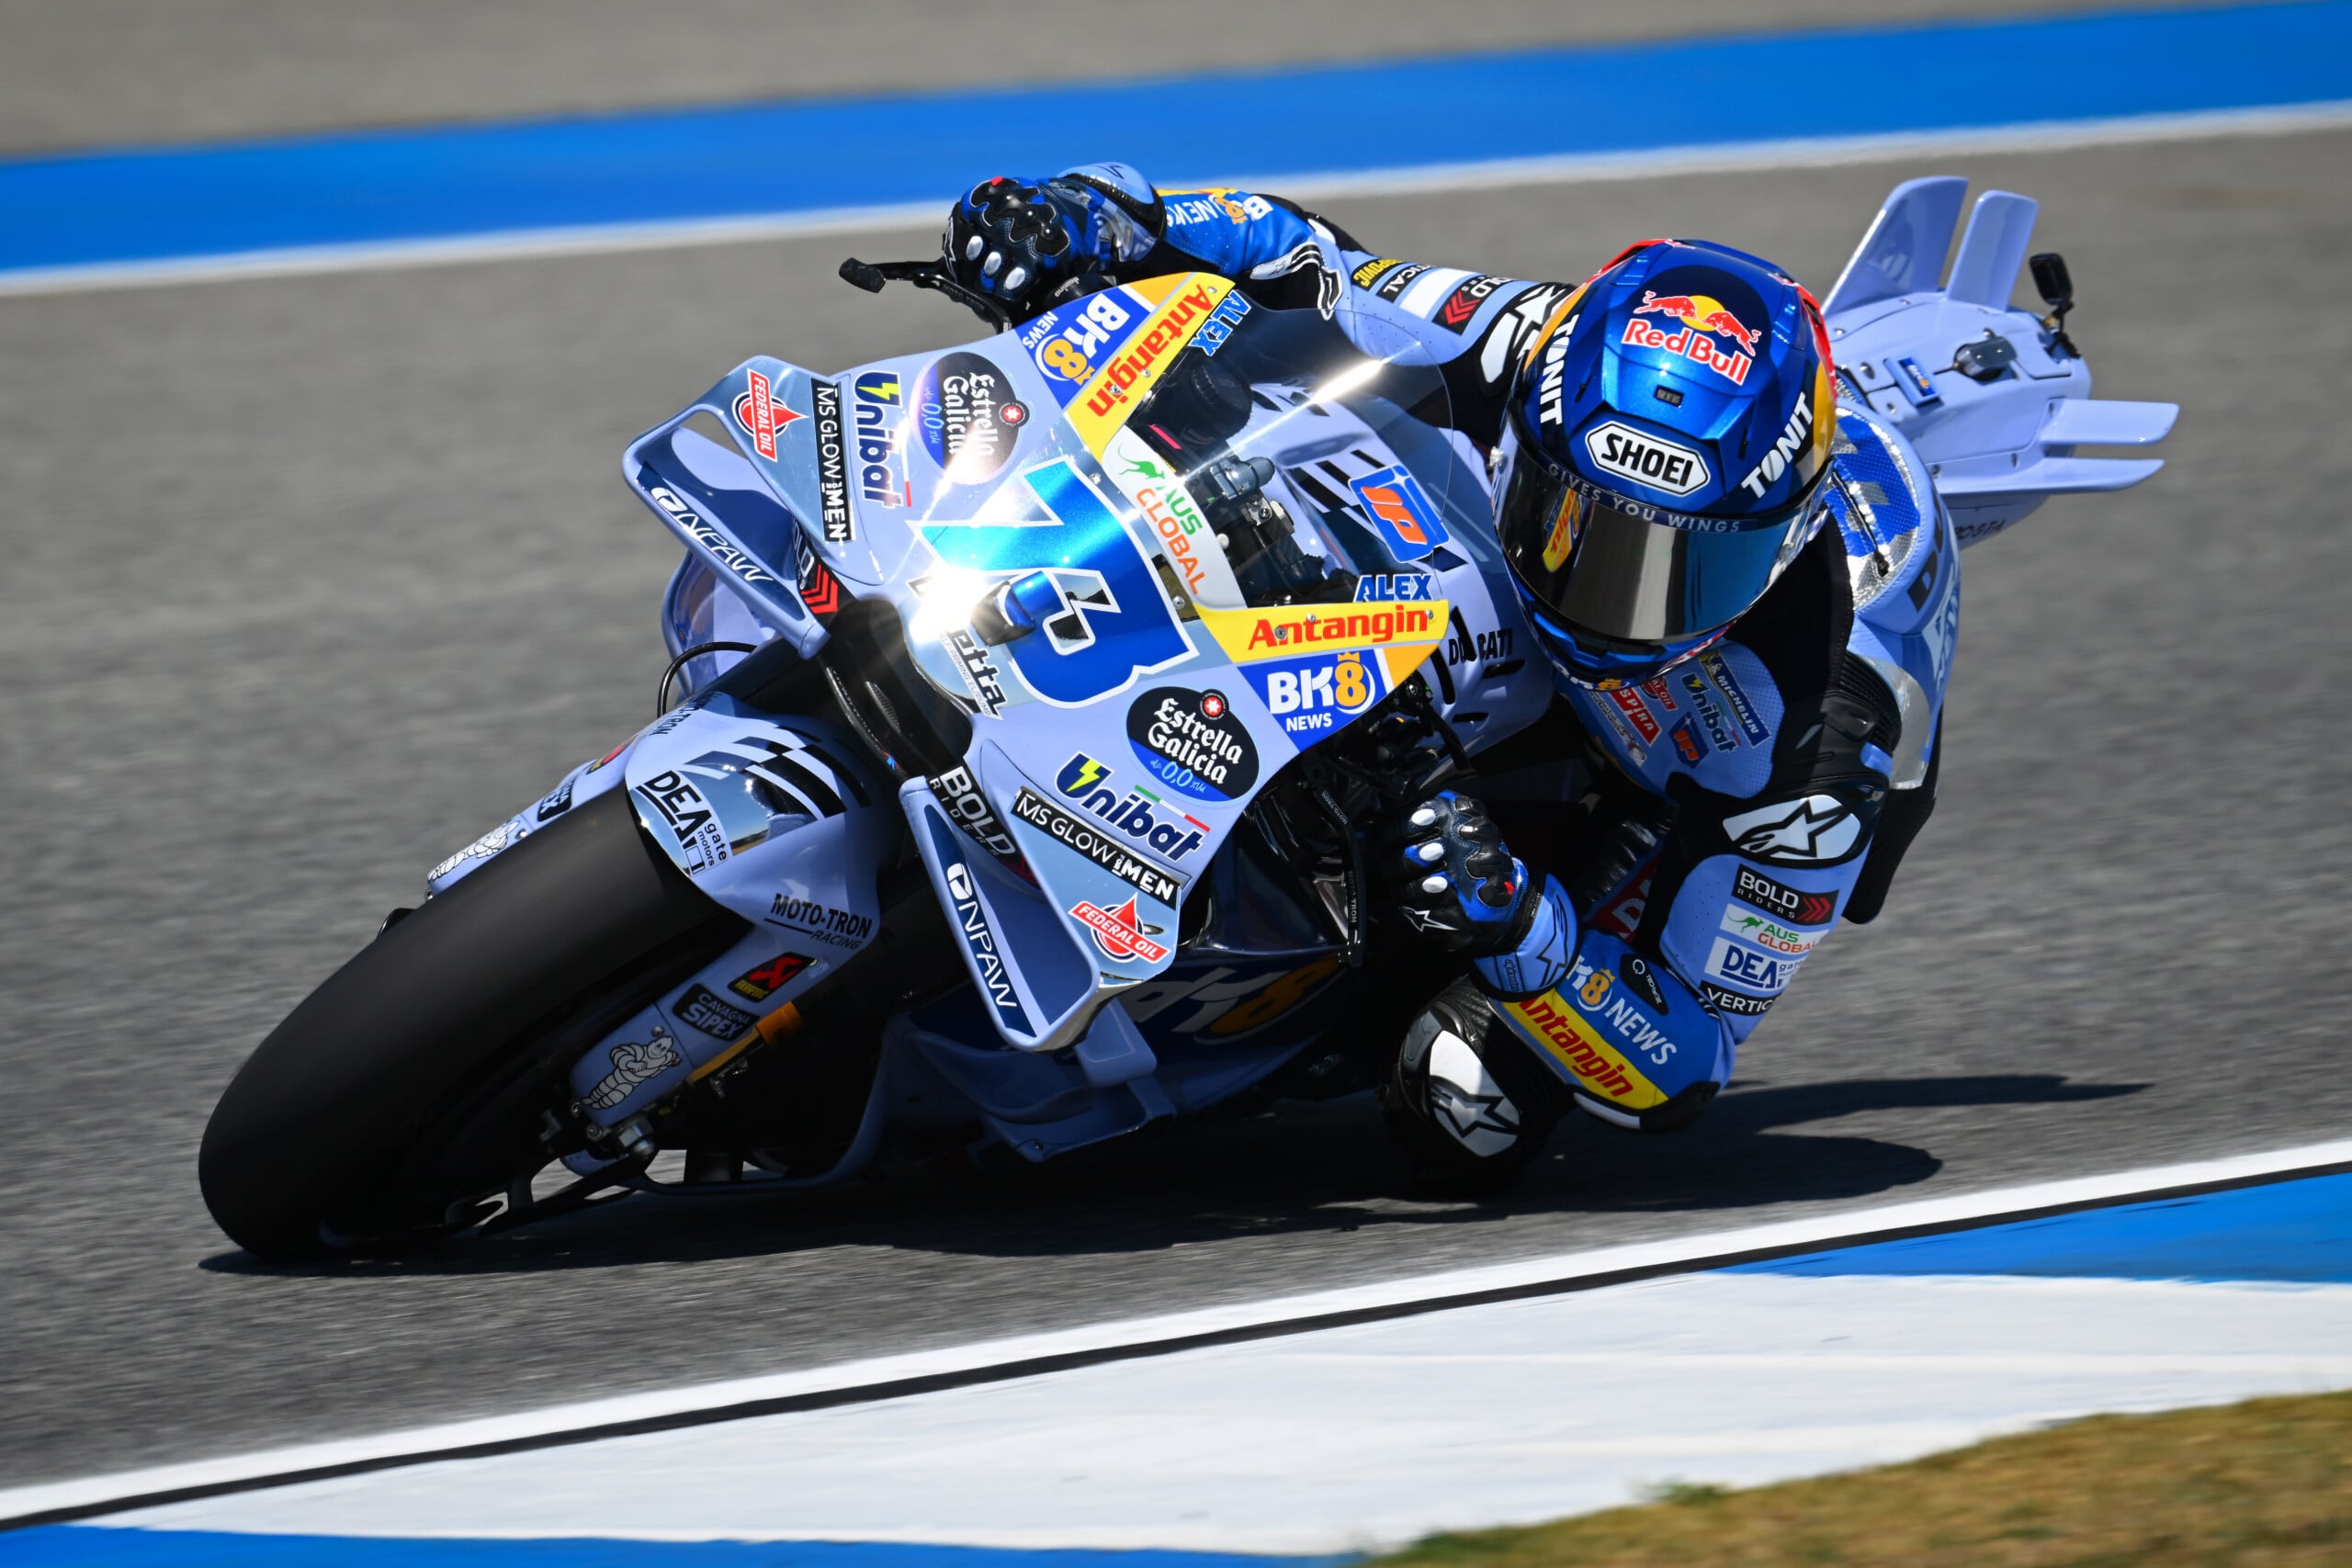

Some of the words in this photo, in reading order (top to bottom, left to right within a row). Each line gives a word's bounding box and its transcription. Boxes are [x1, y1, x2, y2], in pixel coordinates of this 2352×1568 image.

[1470, 276, 1514, 299] OLD
[1022, 310, 1059, 350] NEWS
[1041, 292, 1131, 380] BK8
[1086, 284, 1214, 417] Antangin
[1187, 288, 1251, 356] ALEX
[1622, 318, 1692, 357] Red
[1686, 328, 1753, 386] Bull
[1540, 313, 1580, 426] TONIT
[753, 376, 771, 430] FEDERAL
[817, 387, 839, 416] MS
[943, 376, 972, 456] Galicia
[969, 372, 1000, 457] Estrella
[758, 432, 773, 452] OIL
[820, 419, 842, 479] GLOW
[853, 370, 904, 509] Unibat
[1600, 432, 1695, 487] SHOEI
[1741, 391, 1814, 499] TONIT
[824, 489, 847, 539] MEN
[1155, 485, 1204, 536] AUS
[1548, 462, 1602, 502] GIVES
[1611, 497, 1656, 522] YOU
[1667, 513, 1741, 533] WINGS
[650, 486, 774, 582] ONPAW
[1136, 487, 1206, 595] GLOBAL
[1352, 574, 1433, 604] ALEX
[1248, 604, 1429, 650] Antangin
[1266, 661, 1371, 715] BK8
[1681, 673, 1739, 752] Unibat
[1716, 674, 1760, 735] MICHELIN
[1153, 697, 1243, 764] Estrella
[1285, 712, 1333, 732] NEWS
[1148, 721, 1227, 784] Galicia
[1161, 761, 1194, 787] 0,0
[929, 777, 1001, 856] RIDERS
[939, 765, 1016, 854] BOLD
[1055, 751, 1207, 862] Unibat
[696, 829, 715, 867] motors
[705, 821, 728, 862] gate
[1016, 793, 1052, 826] MS
[1051, 817, 1117, 863] GLOW
[1120, 859, 1175, 901] MEN
[770, 893, 873, 939] MOTO-TRON
[1736, 887, 1796, 919] RIDERS
[1739, 870, 1800, 909] BOLD
[809, 930, 864, 951] RACING
[946, 862, 1018, 1009] ONPAW
[1078, 905, 1132, 945] FEDERAL
[1134, 940, 1159, 958] OIL
[1764, 924, 1800, 943] AUS
[682, 1002, 743, 1039] SIPEX
[698, 993, 751, 1024] CAVAGNA
[1566, 954, 1611, 1006] K8
[1604, 998, 1678, 1066] NEWS
[1519, 996, 1634, 1098] Antangin
